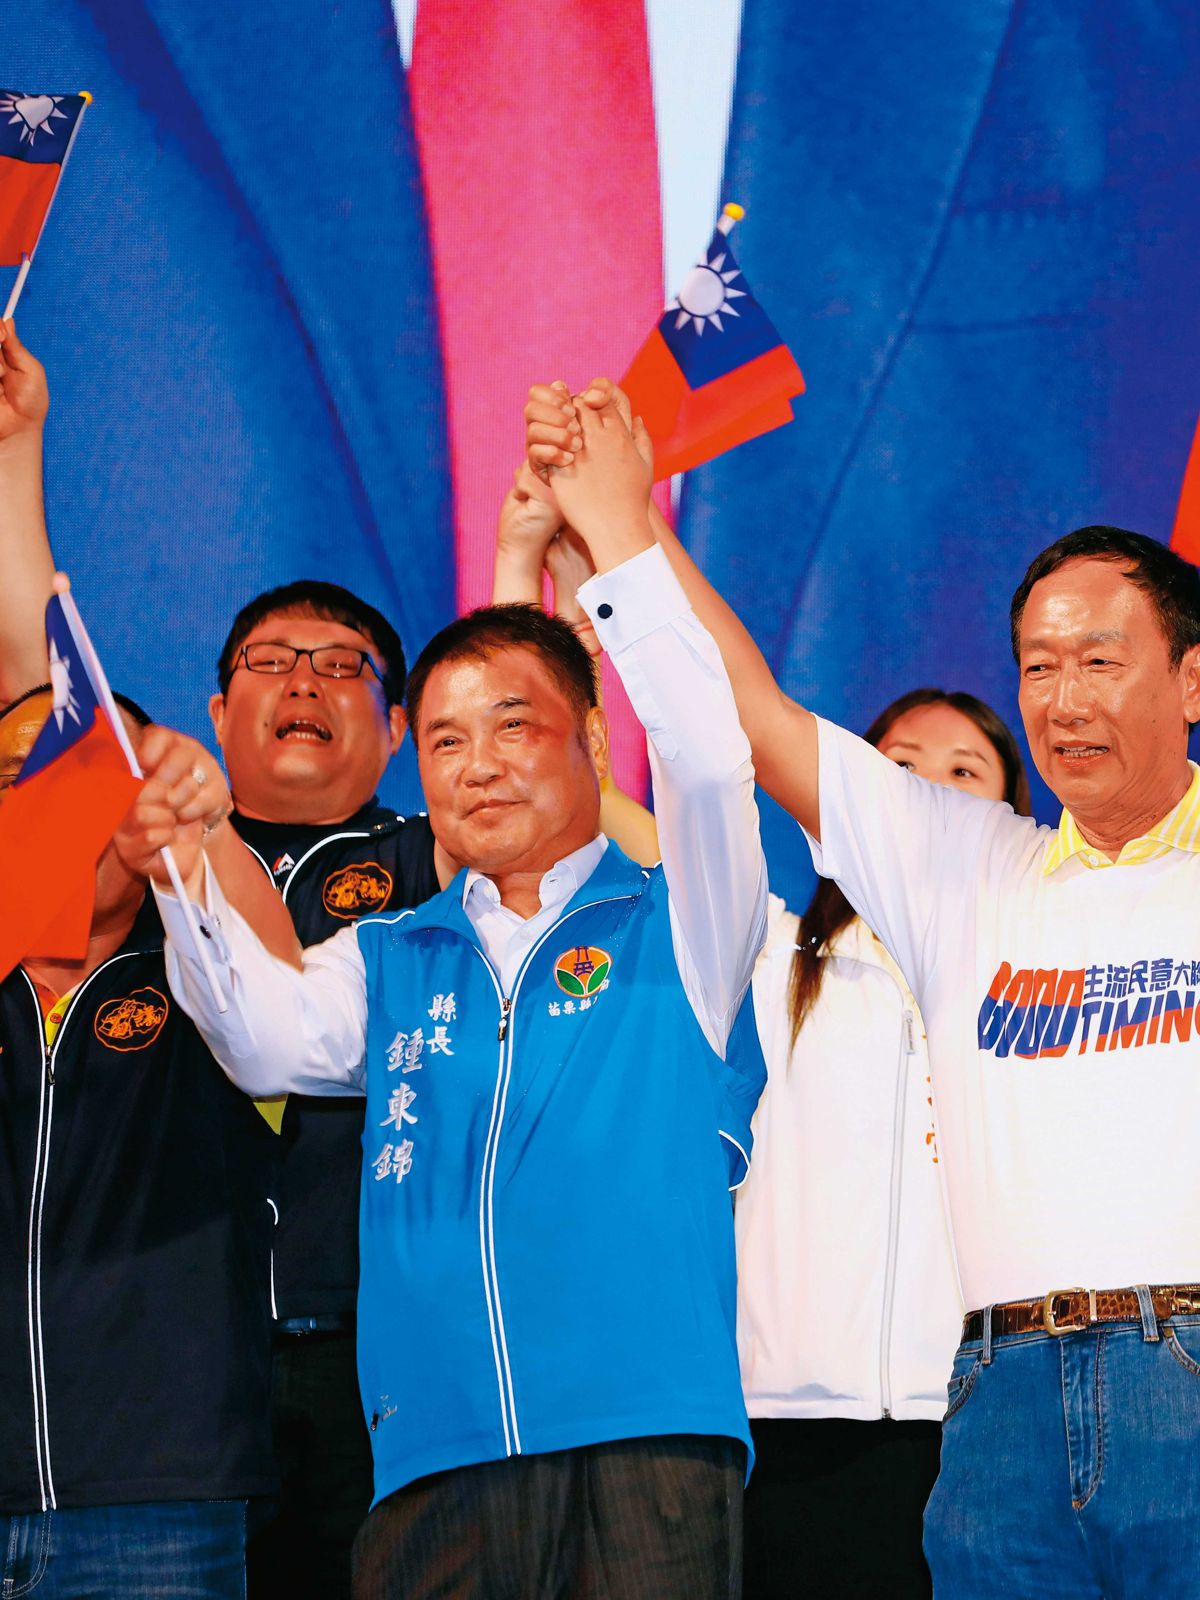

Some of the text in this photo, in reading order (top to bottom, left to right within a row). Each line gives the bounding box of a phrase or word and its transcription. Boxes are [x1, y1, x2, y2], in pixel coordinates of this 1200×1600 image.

[425, 992, 457, 1057] 縣長
[370, 1026, 425, 1185] 鍾東錦
